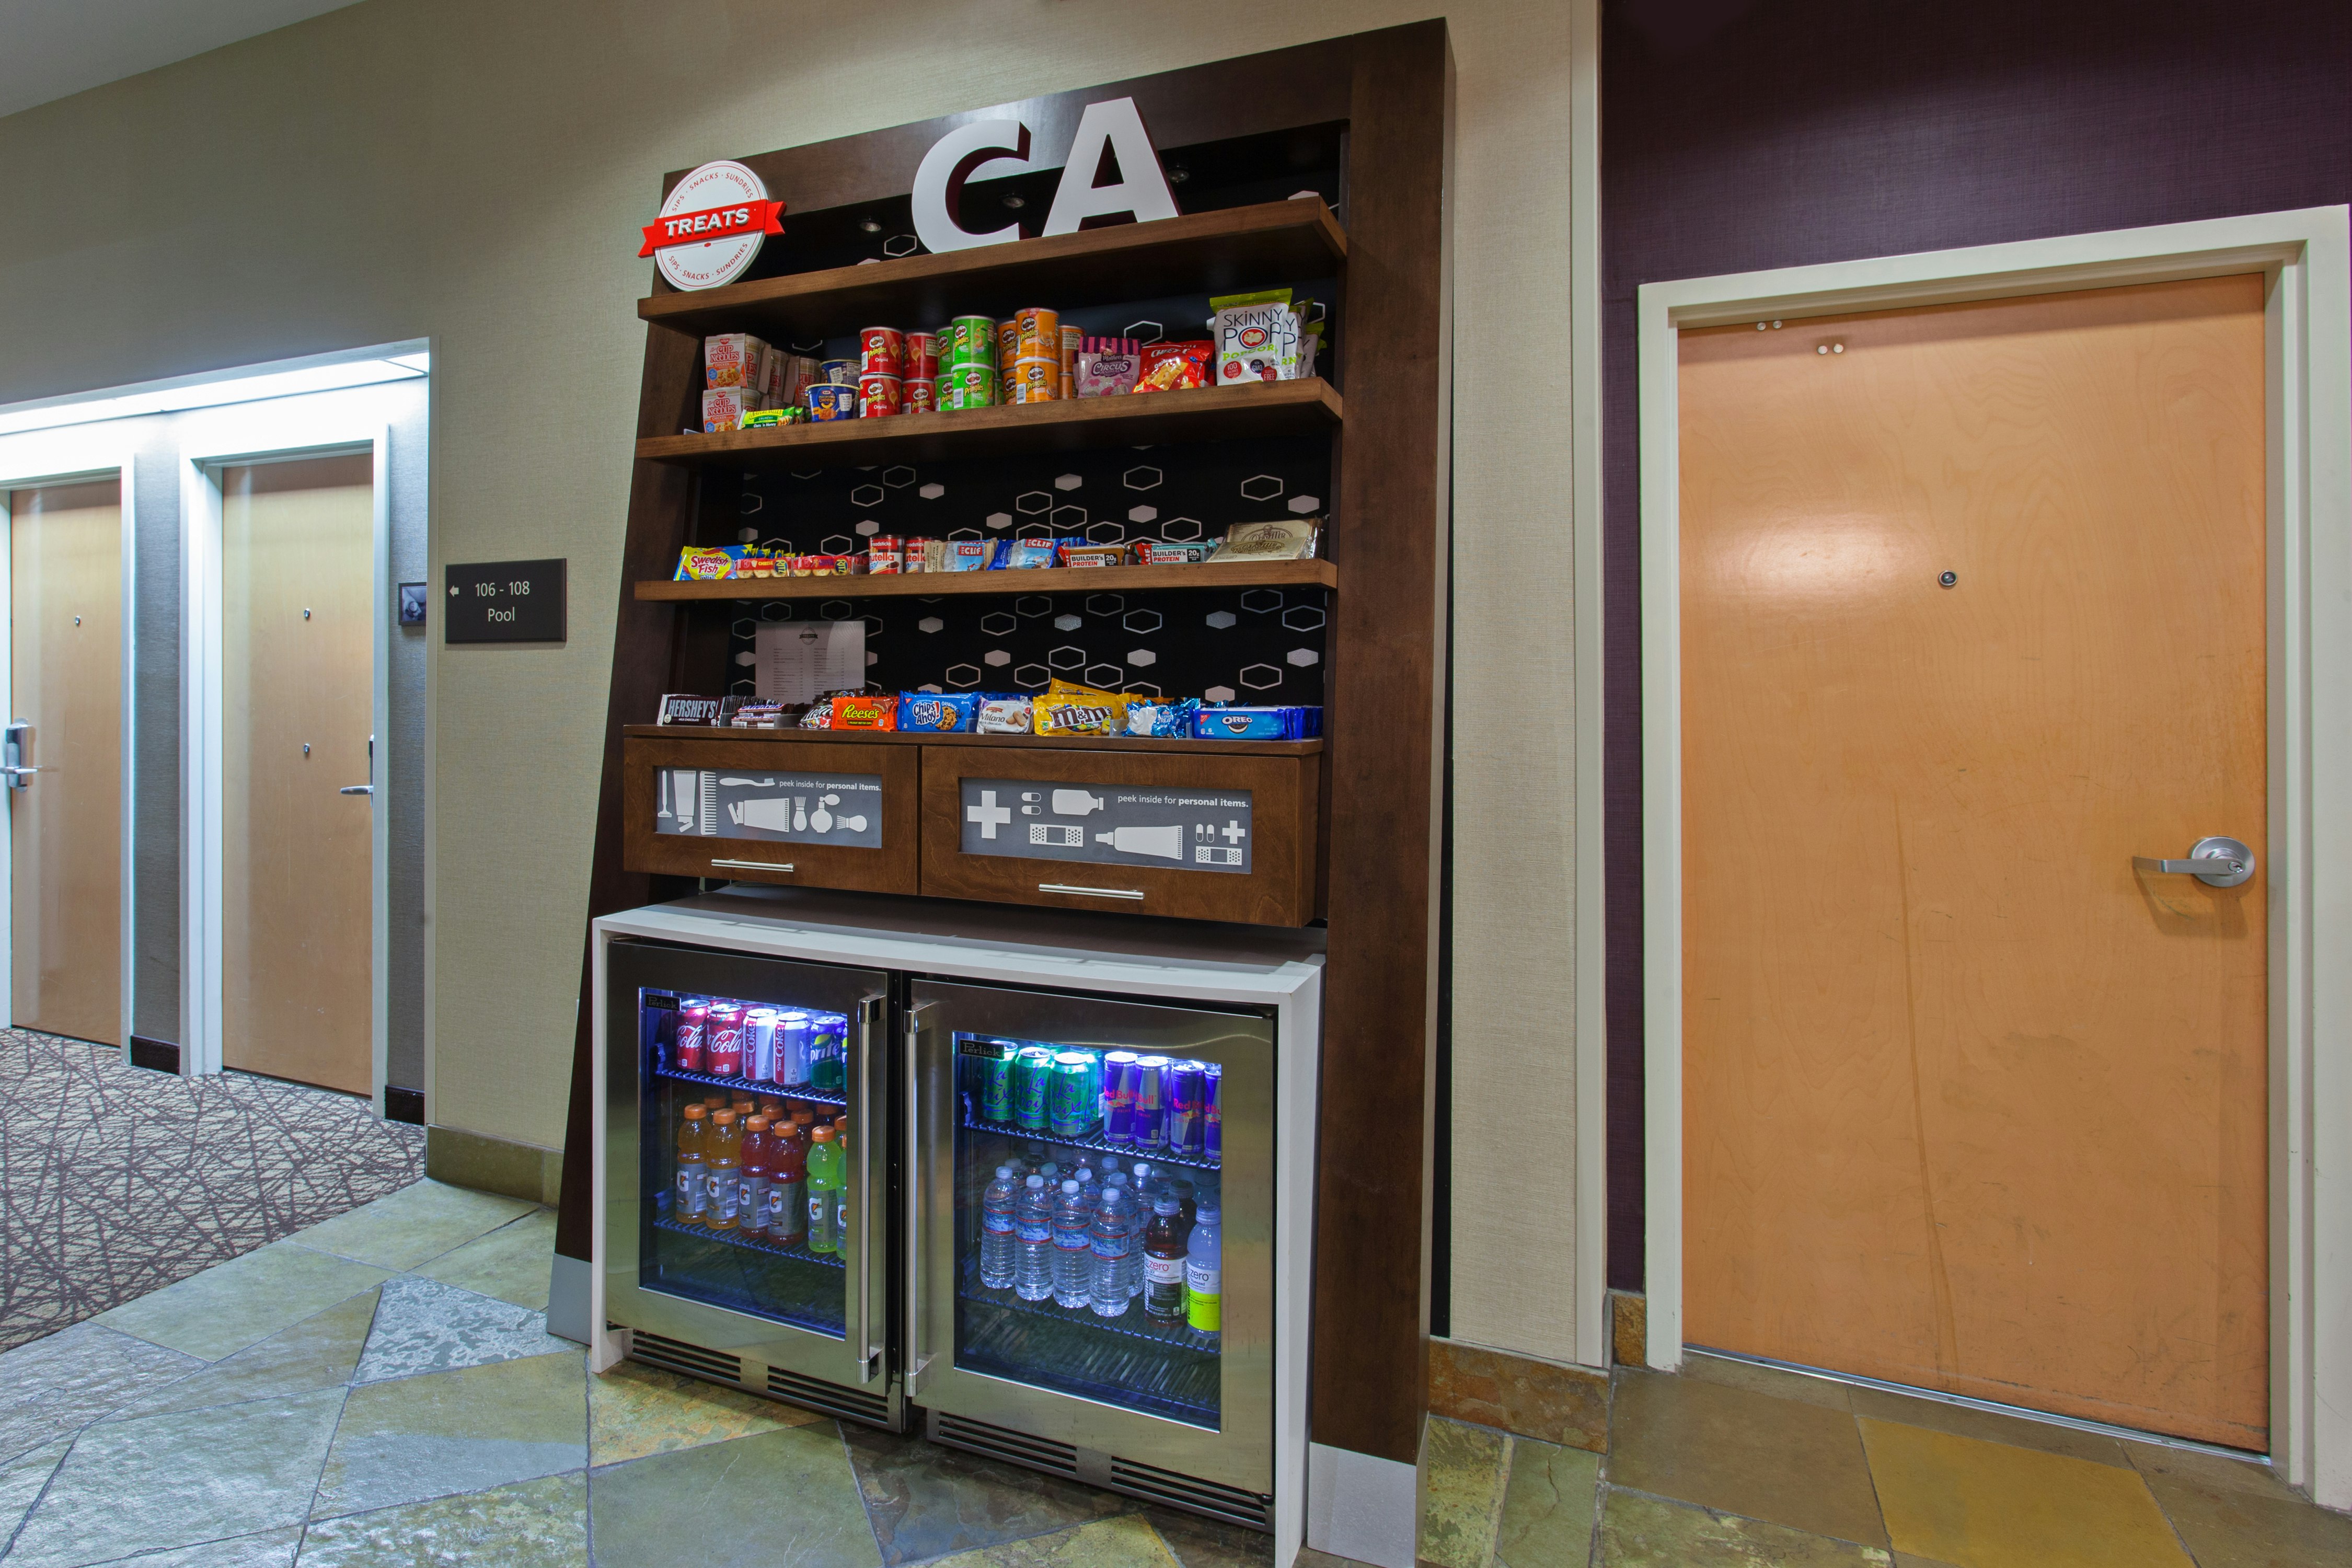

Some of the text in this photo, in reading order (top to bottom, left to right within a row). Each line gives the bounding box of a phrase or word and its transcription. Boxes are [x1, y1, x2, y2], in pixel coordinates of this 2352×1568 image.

[672, 172, 753, 212] SIPS SNACKS SUNDRIES
[665, 208, 749, 238] TREATS
[668, 243, 748, 280] SIPS SNACKS SUNDRIES
[1224, 309, 1283, 327] SKINNY
[1021, 328, 1039, 343] Pringles
[1223, 322, 1281, 351] POP
[717, 345, 733, 354] CUP
[1002, 340, 1016, 353] Pringle
[710, 352, 739, 363] NOODLES
[868, 347, 886, 360] Pringles
[1093, 361, 1129, 374] CIRCUS
[964, 385, 984, 397] Pringles
[1027, 379, 1046, 392] Pringles
[868, 393, 885, 406] Pringles
[941, 394, 953, 405] Pring
[1005, 389, 1016, 400] Pringl
[713, 398, 730, 407] CUP
[912, 399, 930, 411] Pringles
[708, 405, 736, 416] NOODLES
[691, 555, 729, 568] Swedish
[776, 559, 787, 573] RITZ
[837, 559, 846, 573] RITZ
[698, 564, 718, 573] Fish
[475, 582, 495, 597] 106
[509, 581, 530, 595] 108
[488, 607, 515, 622] Pool
[668, 700, 716, 718] HERSHEY'S
[842, 704, 879, 718] Reese's
[914, 703, 935, 716] Chips
[941, 701, 957, 711] ORIGINAL
[981, 713, 1005, 722] Milano
[1222, 716, 1253, 724] OREO
[1118, 794, 1249, 808] peek inside for personal items.
[648, 996, 677, 1009] Perlick
[746, 1023, 755, 1053] Coke
[776, 1027, 784, 1057] Coke
[811, 1041, 840, 1064] prite
[963, 1042, 1001, 1057] Perlick
[1026, 1067, 1045, 1094] La
[1056, 1073, 1075, 1100] La
[1116, 1090, 1134, 1100] Bull
[1138, 1093, 1154, 1104] Bull
[1173, 1099, 1190, 1110] Red
[677, 1171, 689, 1192] G
[707, 1176, 719, 1197] G
[740, 1183, 750, 1205] G
[769, 1191, 782, 1213] G
[809, 1197, 822, 1220] G
[1149, 1260, 1169, 1272] zero
[1190, 1269, 1209, 1282] zero
